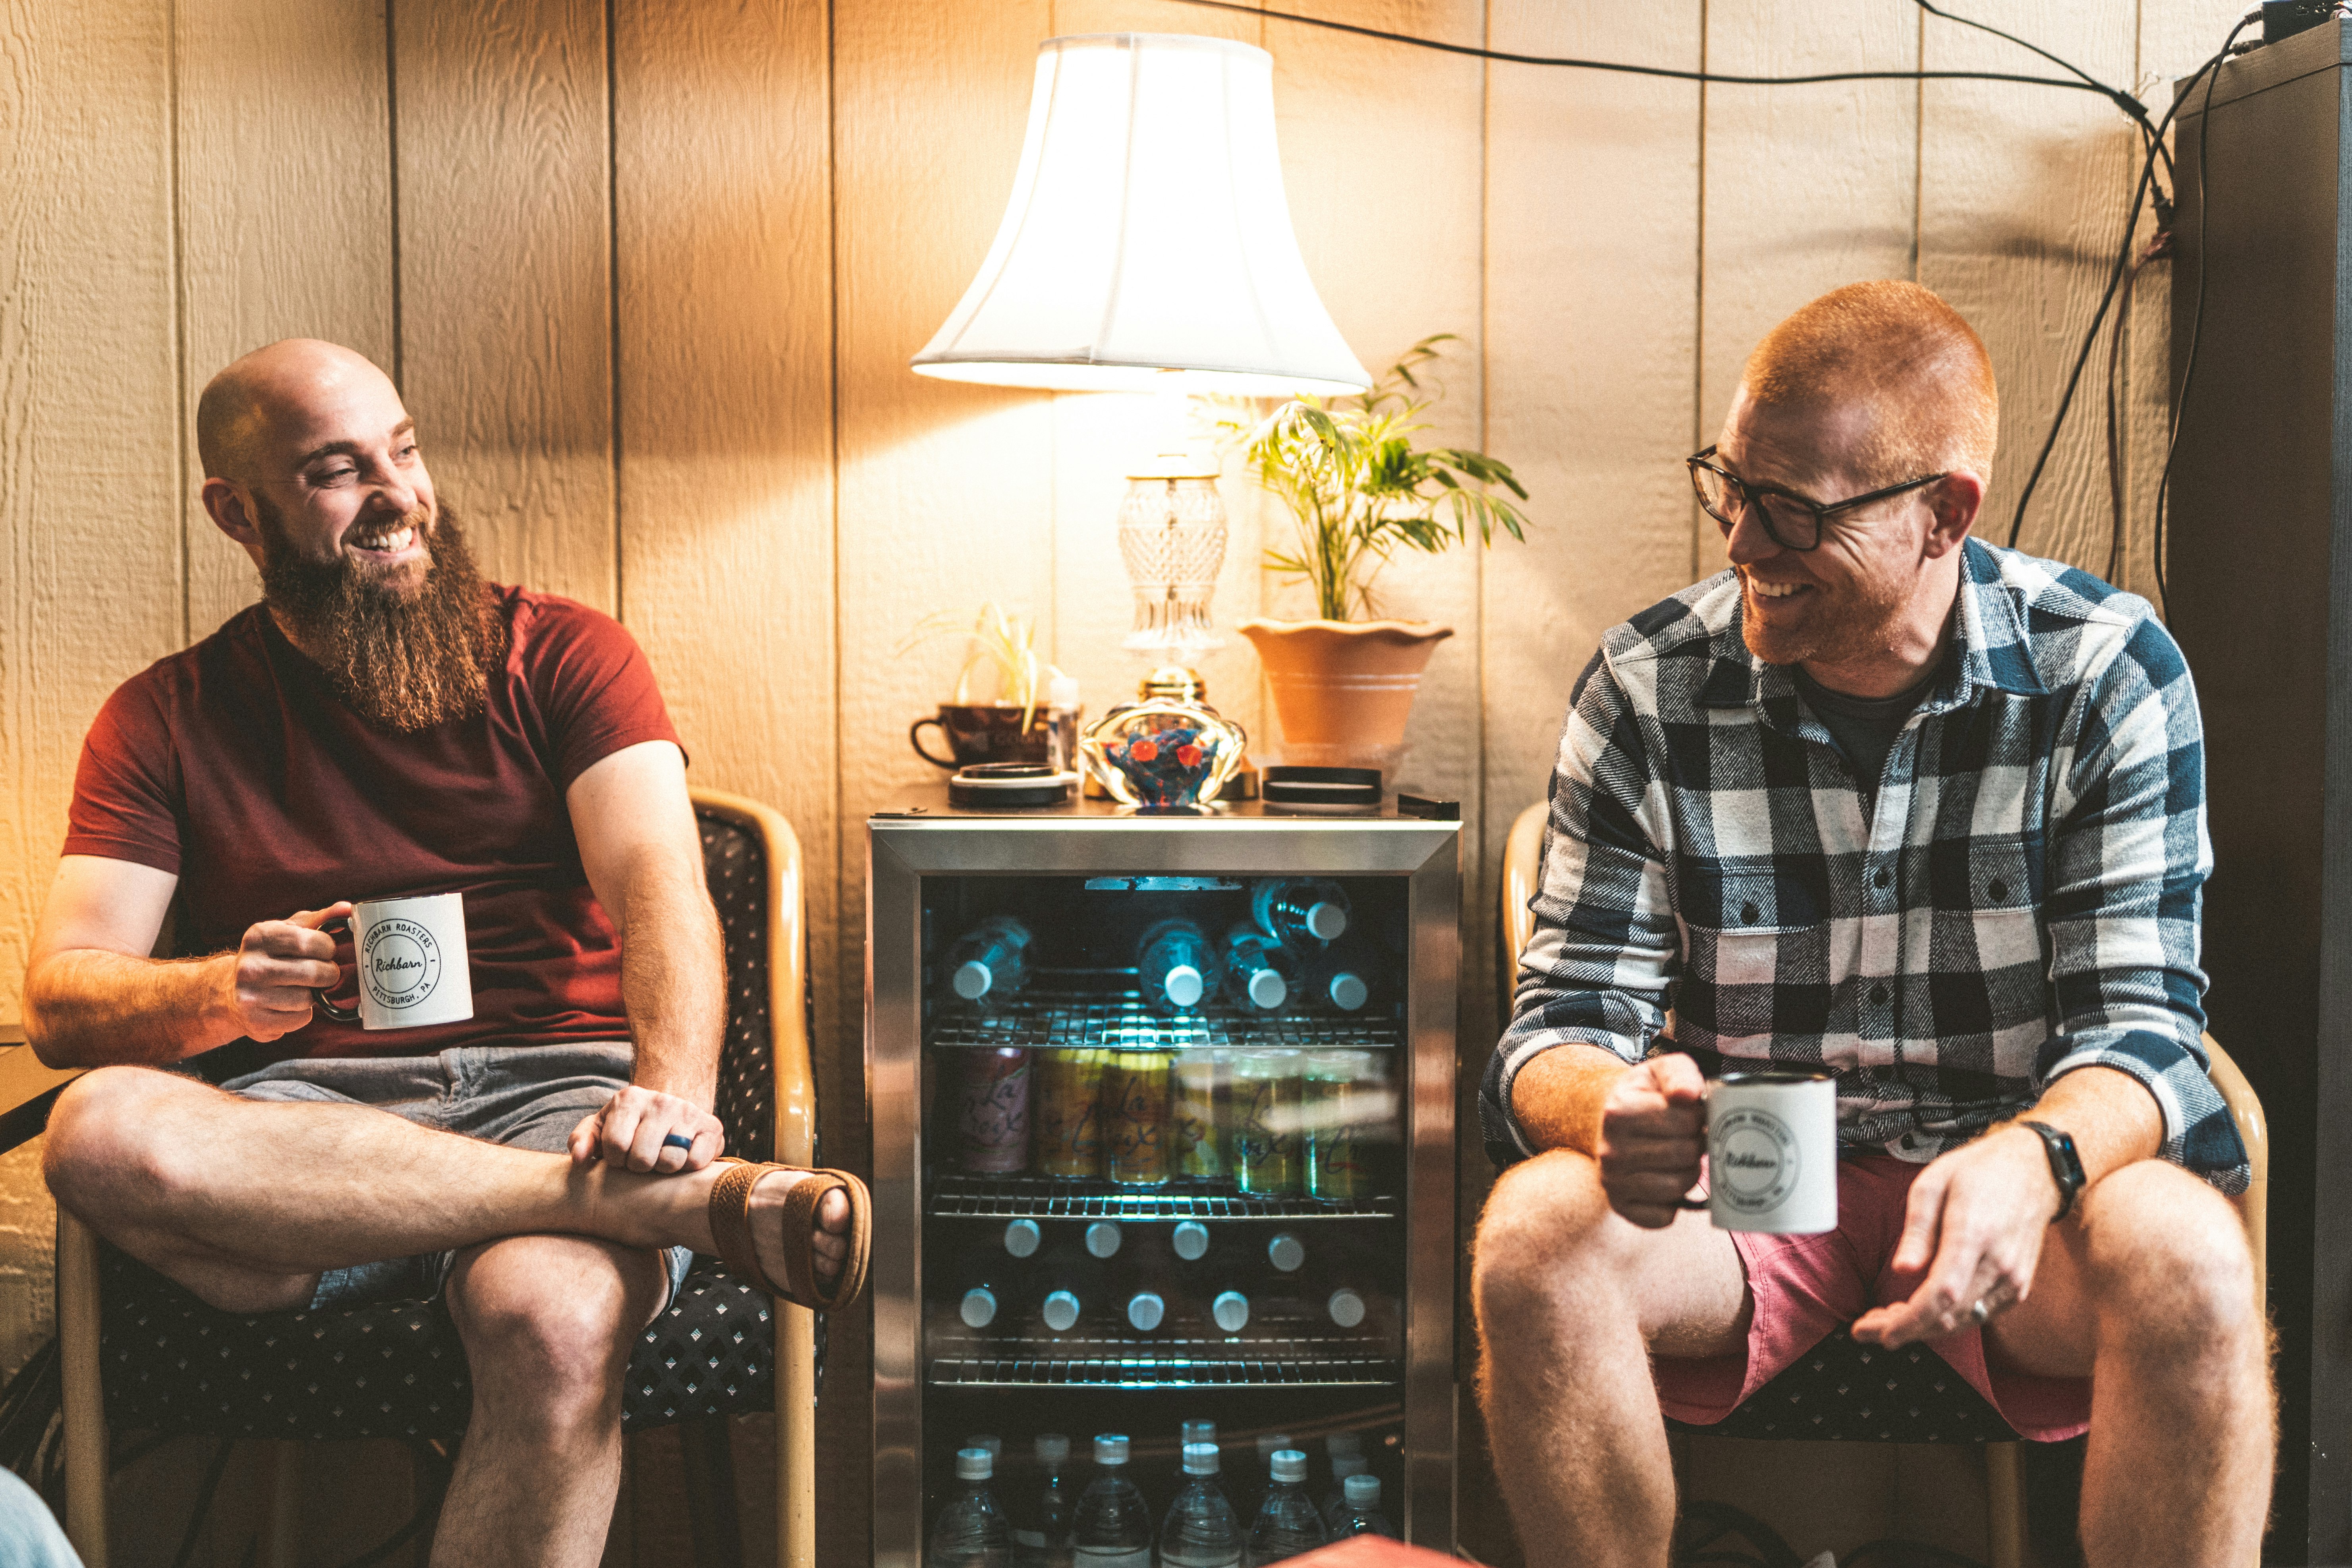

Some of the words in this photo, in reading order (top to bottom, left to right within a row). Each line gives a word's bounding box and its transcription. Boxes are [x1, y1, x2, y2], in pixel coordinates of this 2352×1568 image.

[365, 924, 391, 953] RICHBARN
[396, 923, 432, 948] ROASTERS
[376, 957, 423, 972] Richbarn
[420, 982, 431, 993] PA
